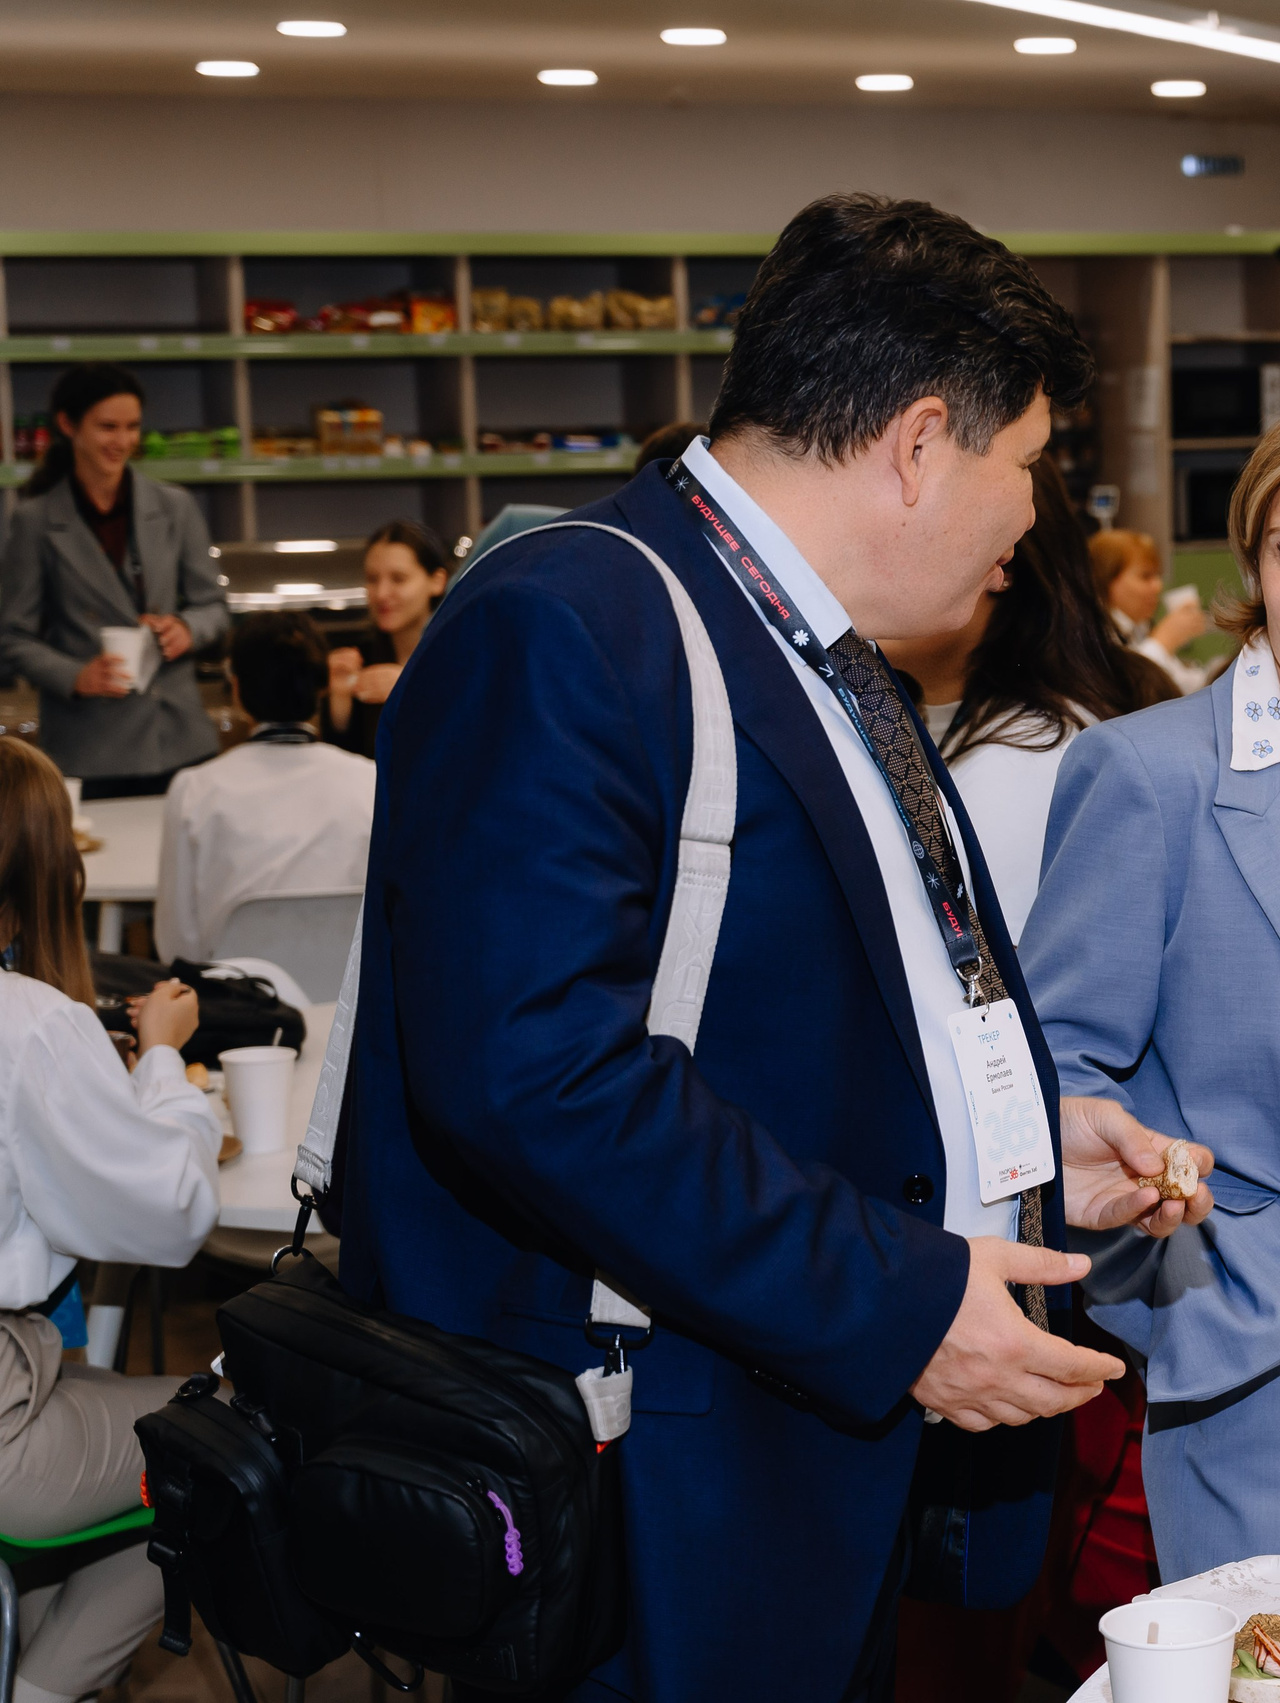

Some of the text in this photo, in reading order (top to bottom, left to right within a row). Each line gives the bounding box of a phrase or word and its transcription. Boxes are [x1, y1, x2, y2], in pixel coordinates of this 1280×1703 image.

[691, 494, 791, 620] БУДУЩЕЕ СЕГОДНЯ
[837, 687, 875, 753] БУДУЩЕЕ
[977, 1030, 1000, 1044] ТРЕКЕР
[986, 1055, 1007, 1069] Андрей
[986, 1069, 1013, 1084] Ермолаев
[984, 1096, 1039, 1162] 365
